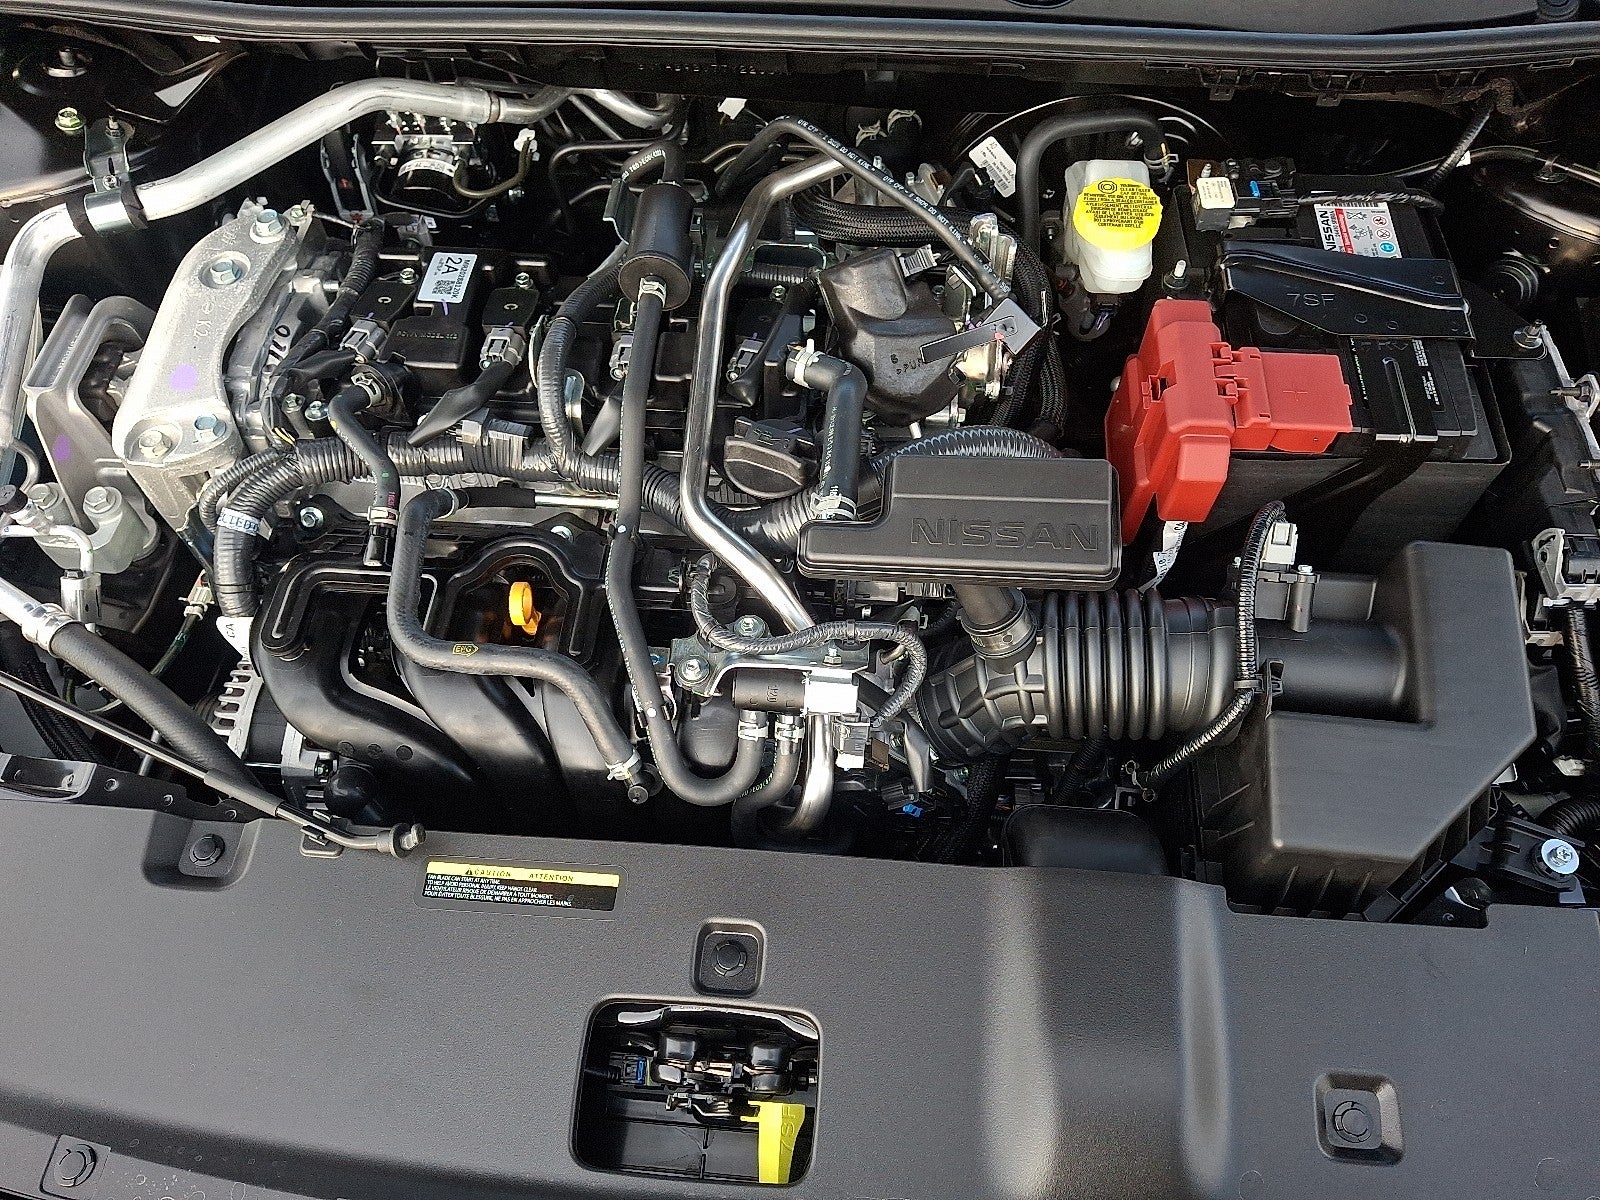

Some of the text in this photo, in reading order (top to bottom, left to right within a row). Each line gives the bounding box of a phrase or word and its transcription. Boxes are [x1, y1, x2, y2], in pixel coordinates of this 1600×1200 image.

[937, 214, 950, 225] NOT
[1319, 210, 1338, 252] NISSAN
[441, 257, 463, 274] 2A
[1287, 293, 1335, 307] 7SF
[910, 517, 1099, 551] NISSAN
[474, 868, 574, 882] CAUTION ATTENTION
